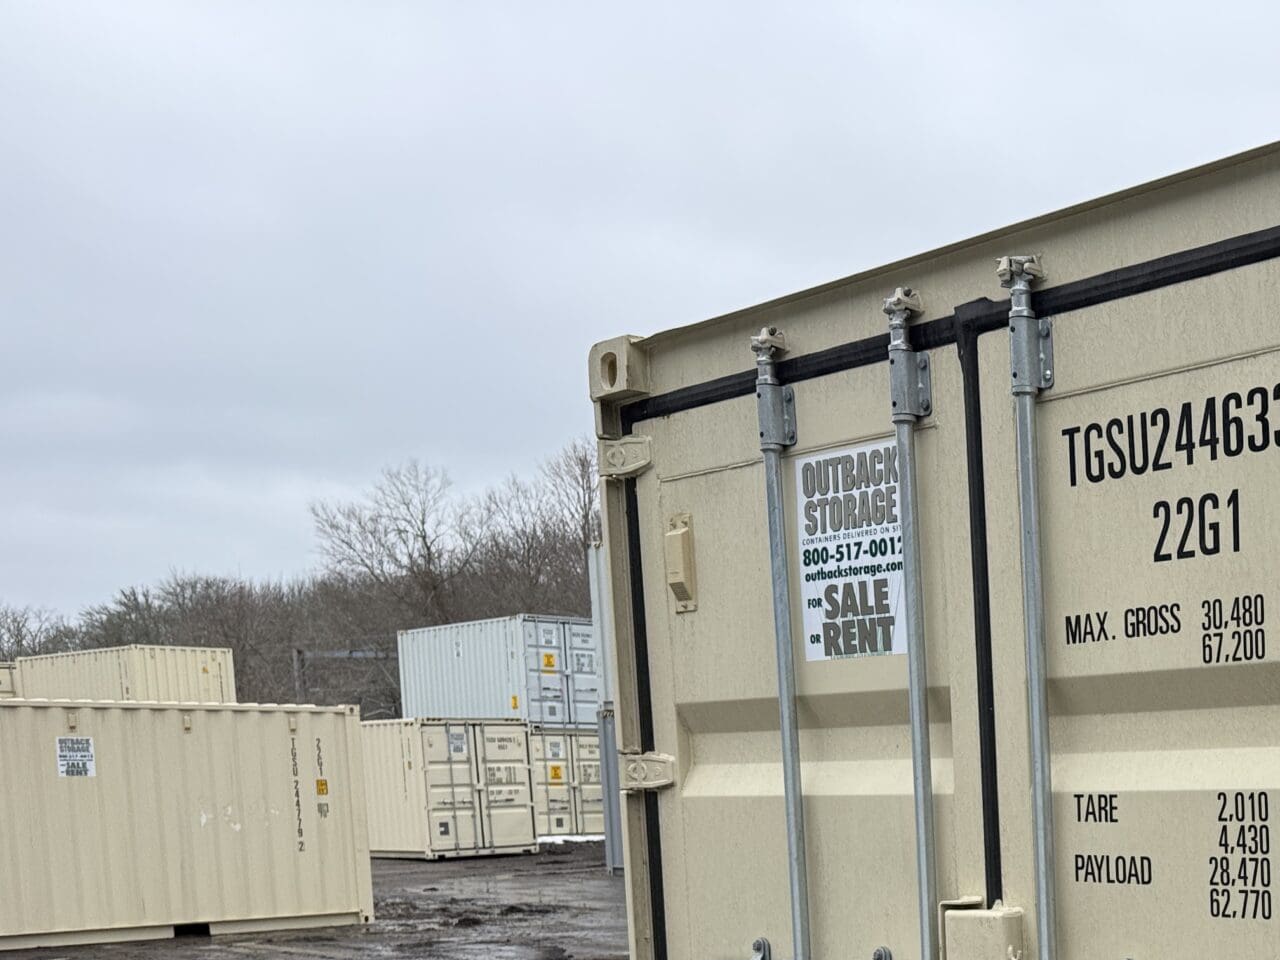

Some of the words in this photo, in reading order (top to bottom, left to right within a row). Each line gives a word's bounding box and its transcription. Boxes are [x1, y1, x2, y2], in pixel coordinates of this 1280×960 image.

[802, 446, 898, 498] OUTBACK
[804, 485, 898, 538] STORAGE
[1153, 489, 1240, 562] 22G1
[802, 533, 841, 546] CONTAINERS
[843, 528, 878, 540] DELIVERED
[880, 526, 890, 535] ON
[808, 598, 823, 609] FOR
[824, 578, 890, 620] SALE
[1065, 611, 1116, 645] MAX.
[1124, 603, 1182, 638] GROSS
[1202, 594, 1265, 631] 30,480
[810, 634, 822, 644] OR
[822, 616, 895, 657] RENT
[1202, 628, 1266, 664] 67,200
[290, 737, 299, 777] TGSU
[298, 841, 305, 852] 2
[1074, 794, 1119, 823] TARE
[1217, 792, 1269, 823] 2,010
[1219, 825, 1270, 855] 4,430
[1075, 855, 1152, 885] PAYLOAD
[1209, 857, 1271, 887] 28,470
[1210, 889, 1272, 920] 62,770
